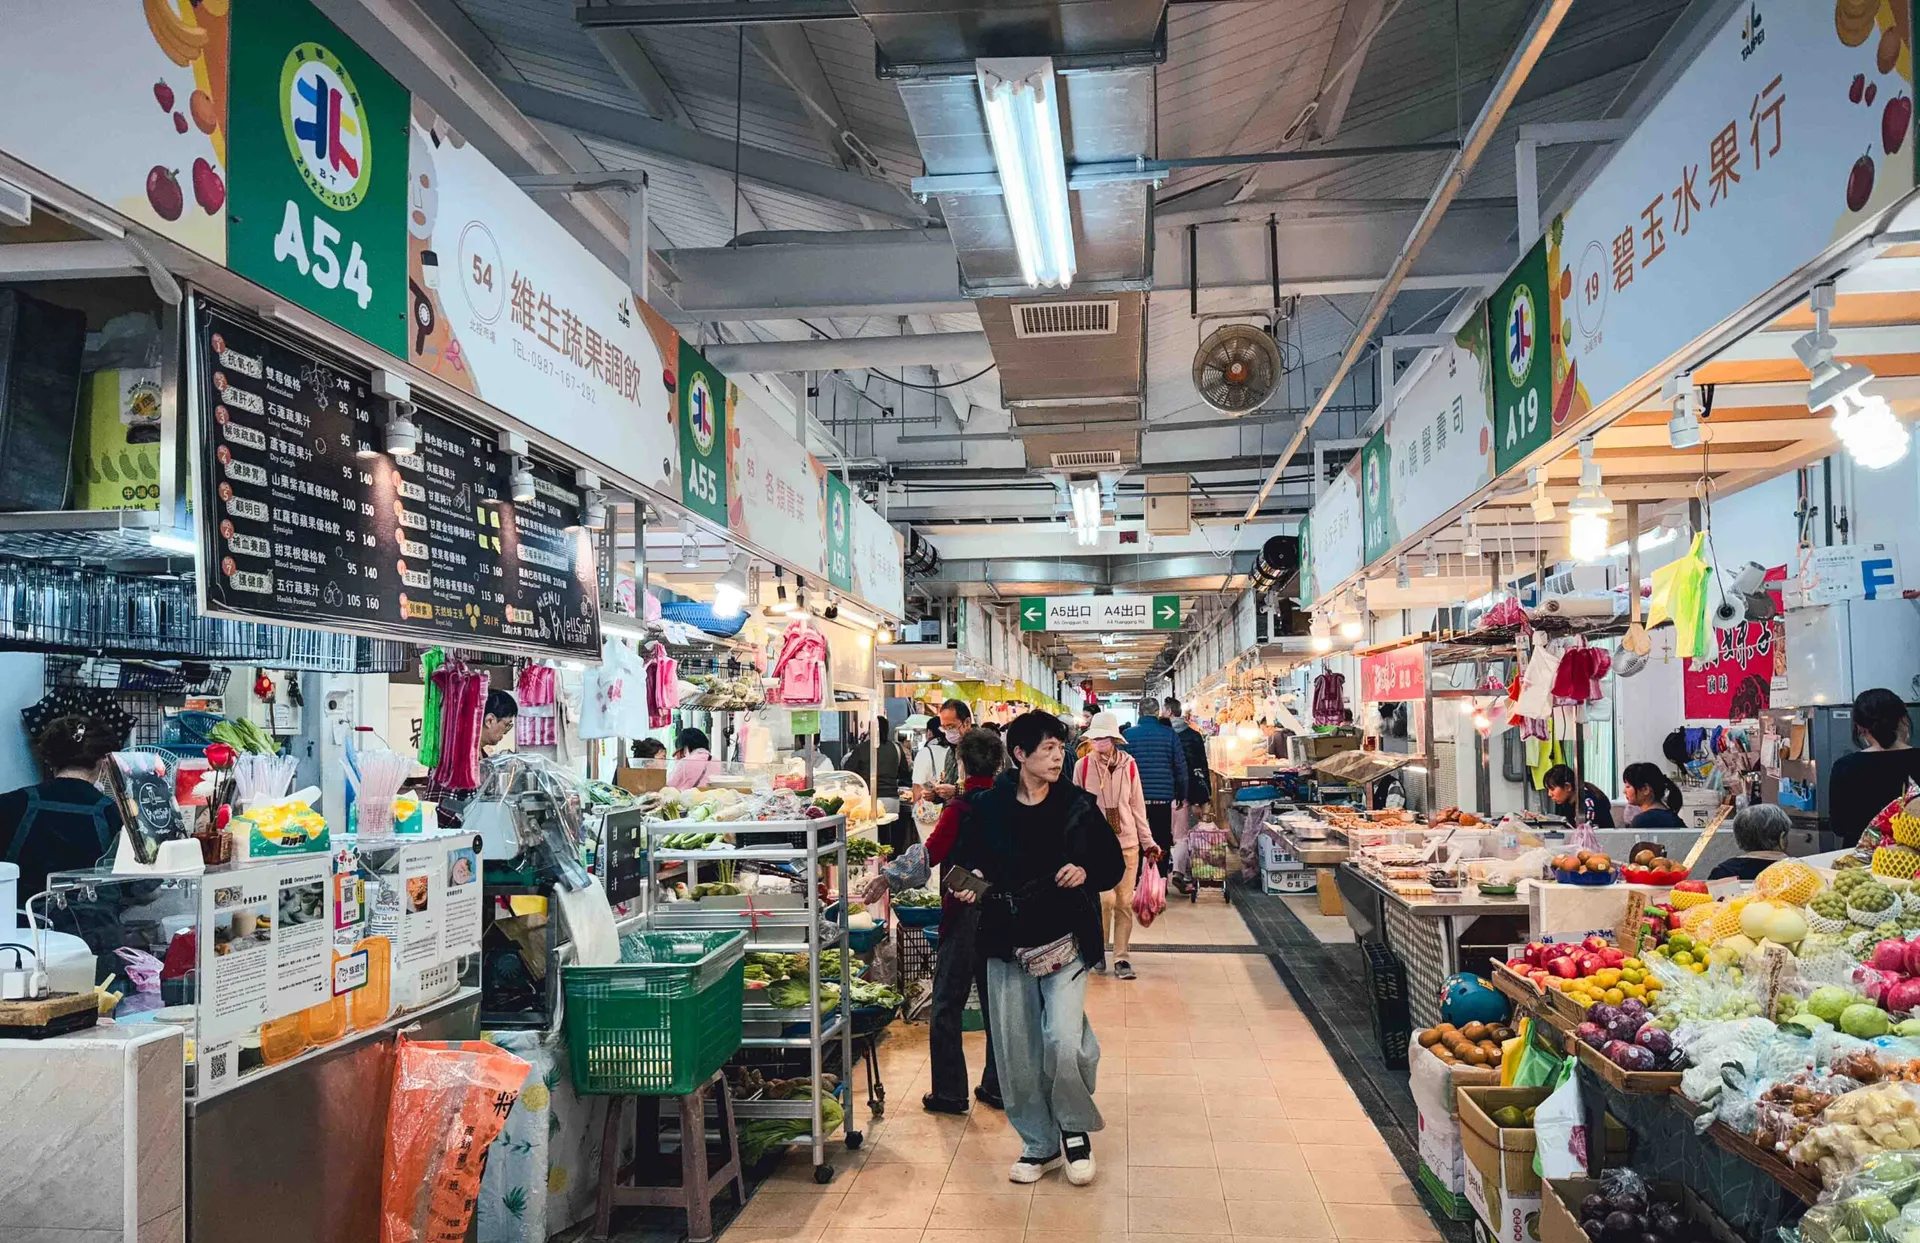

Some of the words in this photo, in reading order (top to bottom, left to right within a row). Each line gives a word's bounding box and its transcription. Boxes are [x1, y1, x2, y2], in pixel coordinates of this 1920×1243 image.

[1612, 73, 1786, 292] 碧玉水果行
[274, 199, 372, 309] A54
[472, 254, 493, 292] 54
[1585, 272, 1598, 305] 19
[511, 270, 641, 407] 維生蔬果調飲
[339, 401, 348, 415] 95
[356, 409, 369, 423] 140
[1507, 388, 1538, 450] A19
[340, 434, 350, 446] 95
[473, 457, 481, 468] 95
[486, 461, 496, 474] 140
[343, 466, 352, 479] 95
[359, 472, 372, 485] 140
[689, 458, 716, 505] A55
[474, 483, 484, 495] 110
[342, 497, 356, 511] 100
[362, 503, 374, 516] 150
[346, 530, 355, 542] 95
[363, 534, 376, 548] 140
[1369, 515, 1382, 551] A18
[348, 563, 357, 575] 95
[364, 566, 377, 579] 140
[479, 563, 489, 573] 115
[493, 566, 502, 577] 160
[347, 594, 361, 607] 105
[366, 596, 379, 610] 160
[481, 590, 491, 600] 115
[494, 593, 504, 604] 160
[536, 592, 561, 612] MENU
[1051, 605, 1090, 617] A5出口
[1105, 605, 1145, 617] A4出口
